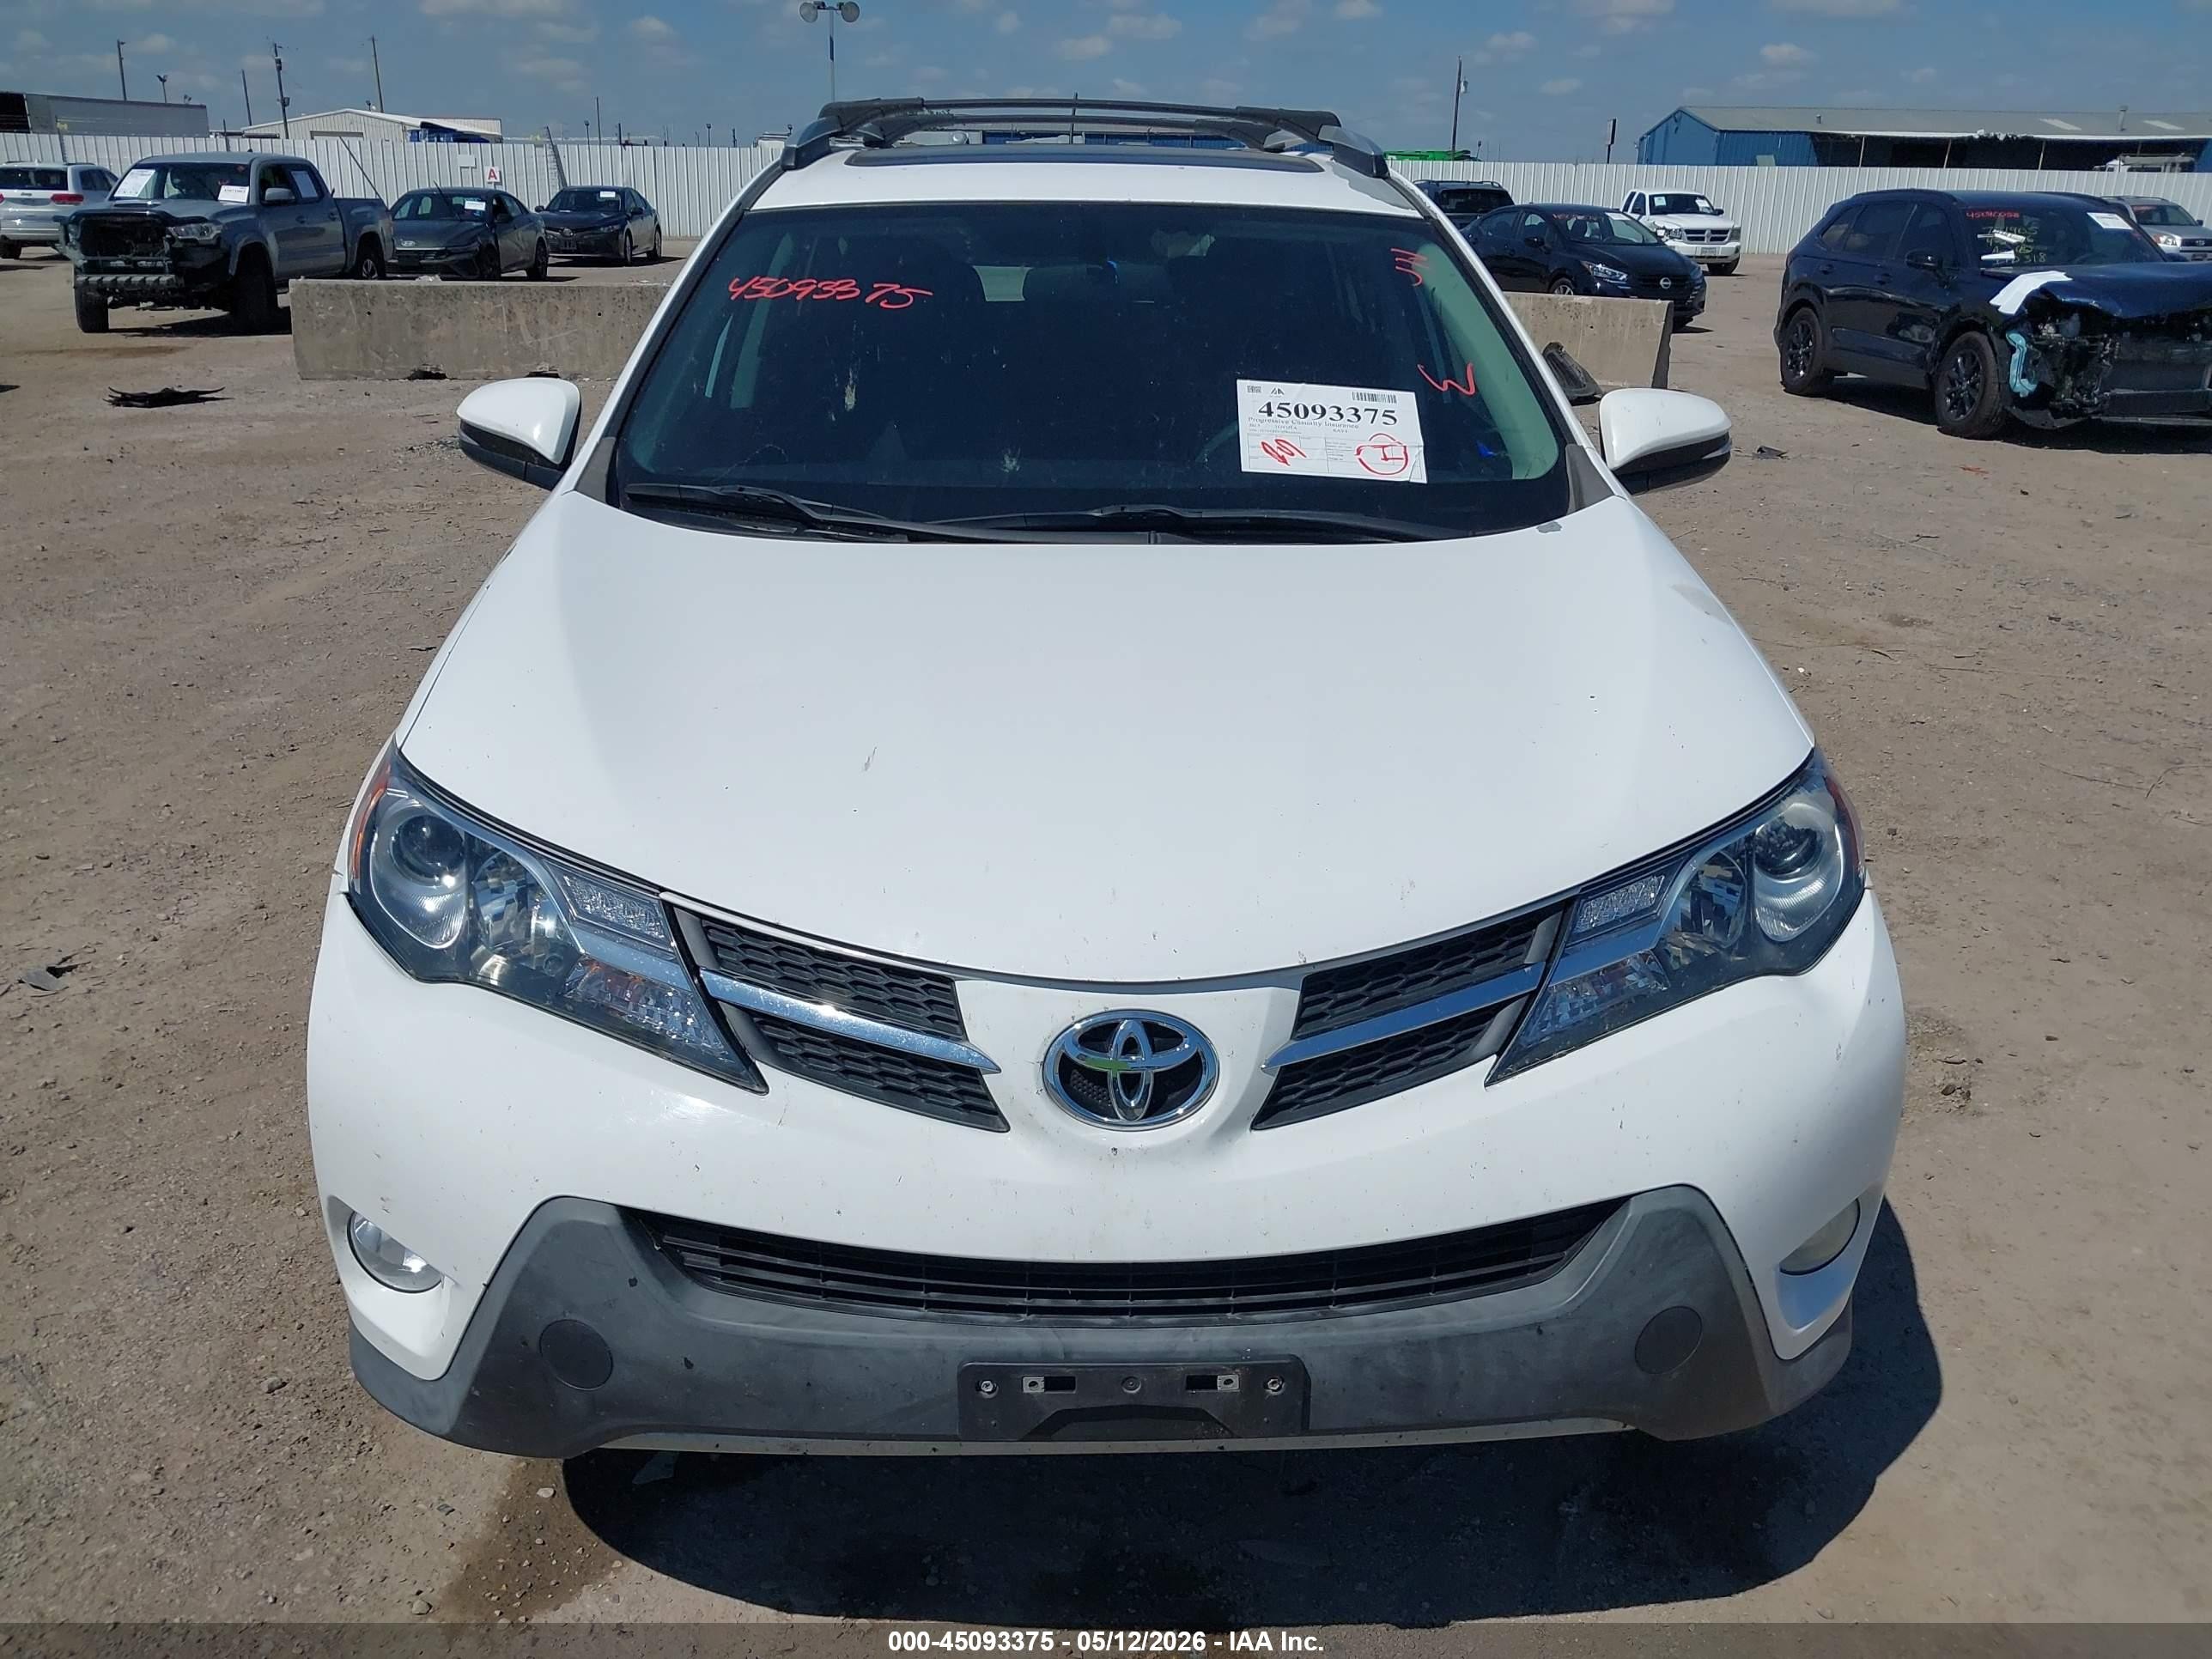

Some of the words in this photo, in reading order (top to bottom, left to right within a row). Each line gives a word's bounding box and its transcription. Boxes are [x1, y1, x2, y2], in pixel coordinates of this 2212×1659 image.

[488, 168, 498, 180] A
[1258, 401, 1398, 426] 45093375
[1248, 416, 1290, 425] Progressive
[1291, 419, 1322, 428] Casualty
[1324, 421, 1359, 429] Insurance
